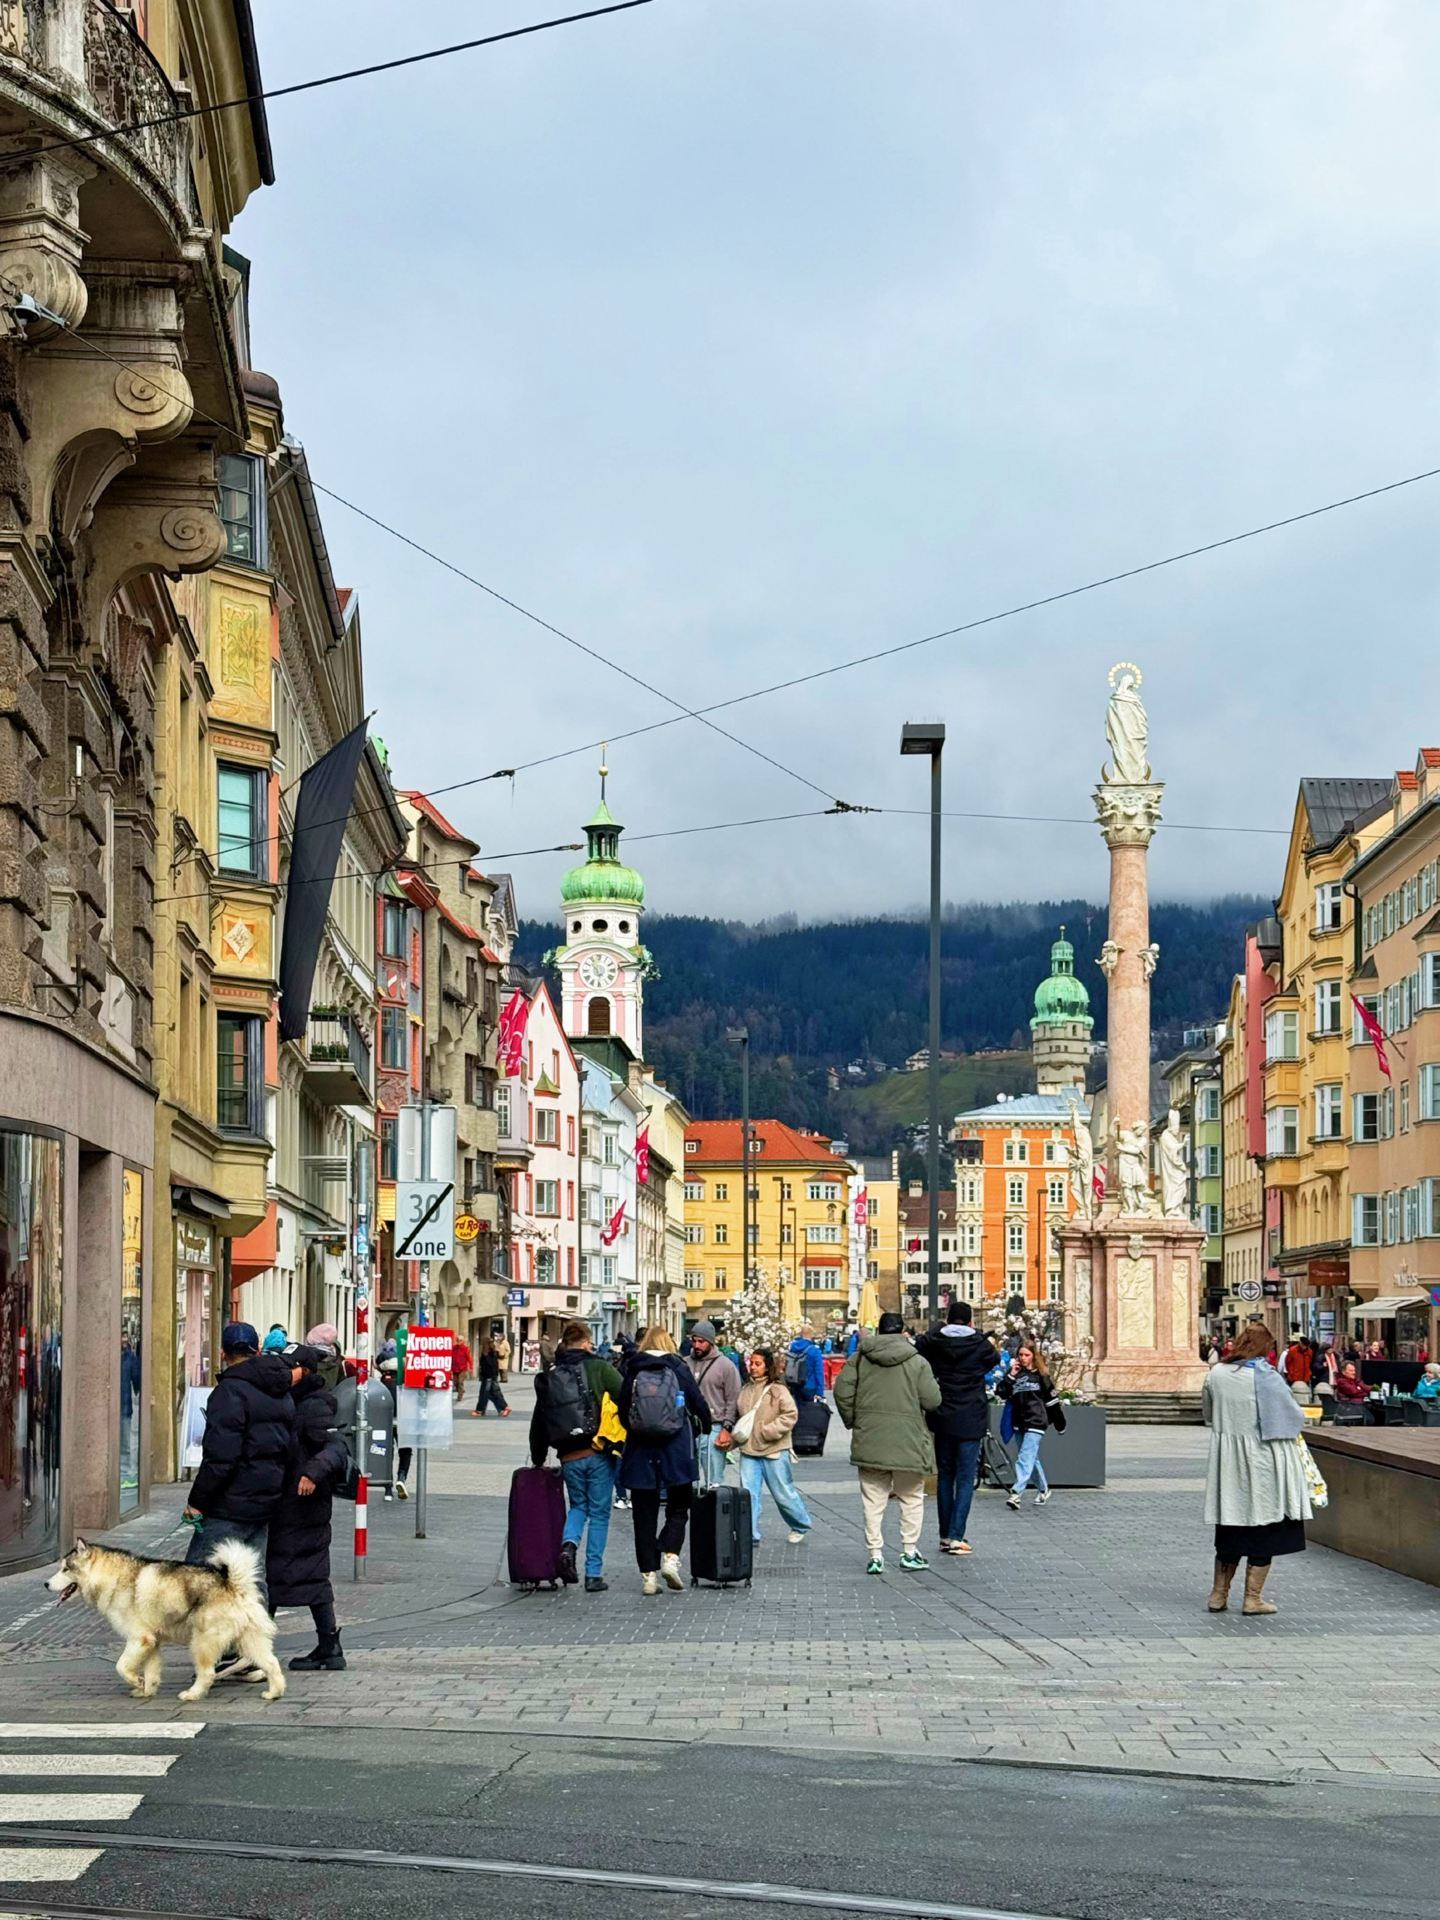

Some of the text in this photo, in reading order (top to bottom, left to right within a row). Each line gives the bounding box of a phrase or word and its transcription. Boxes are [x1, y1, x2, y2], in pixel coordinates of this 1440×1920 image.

[409, 1193, 440, 1223] 30
[406, 1333, 452, 1351] Kronen
[406, 1352, 452, 1371] Zeitung
